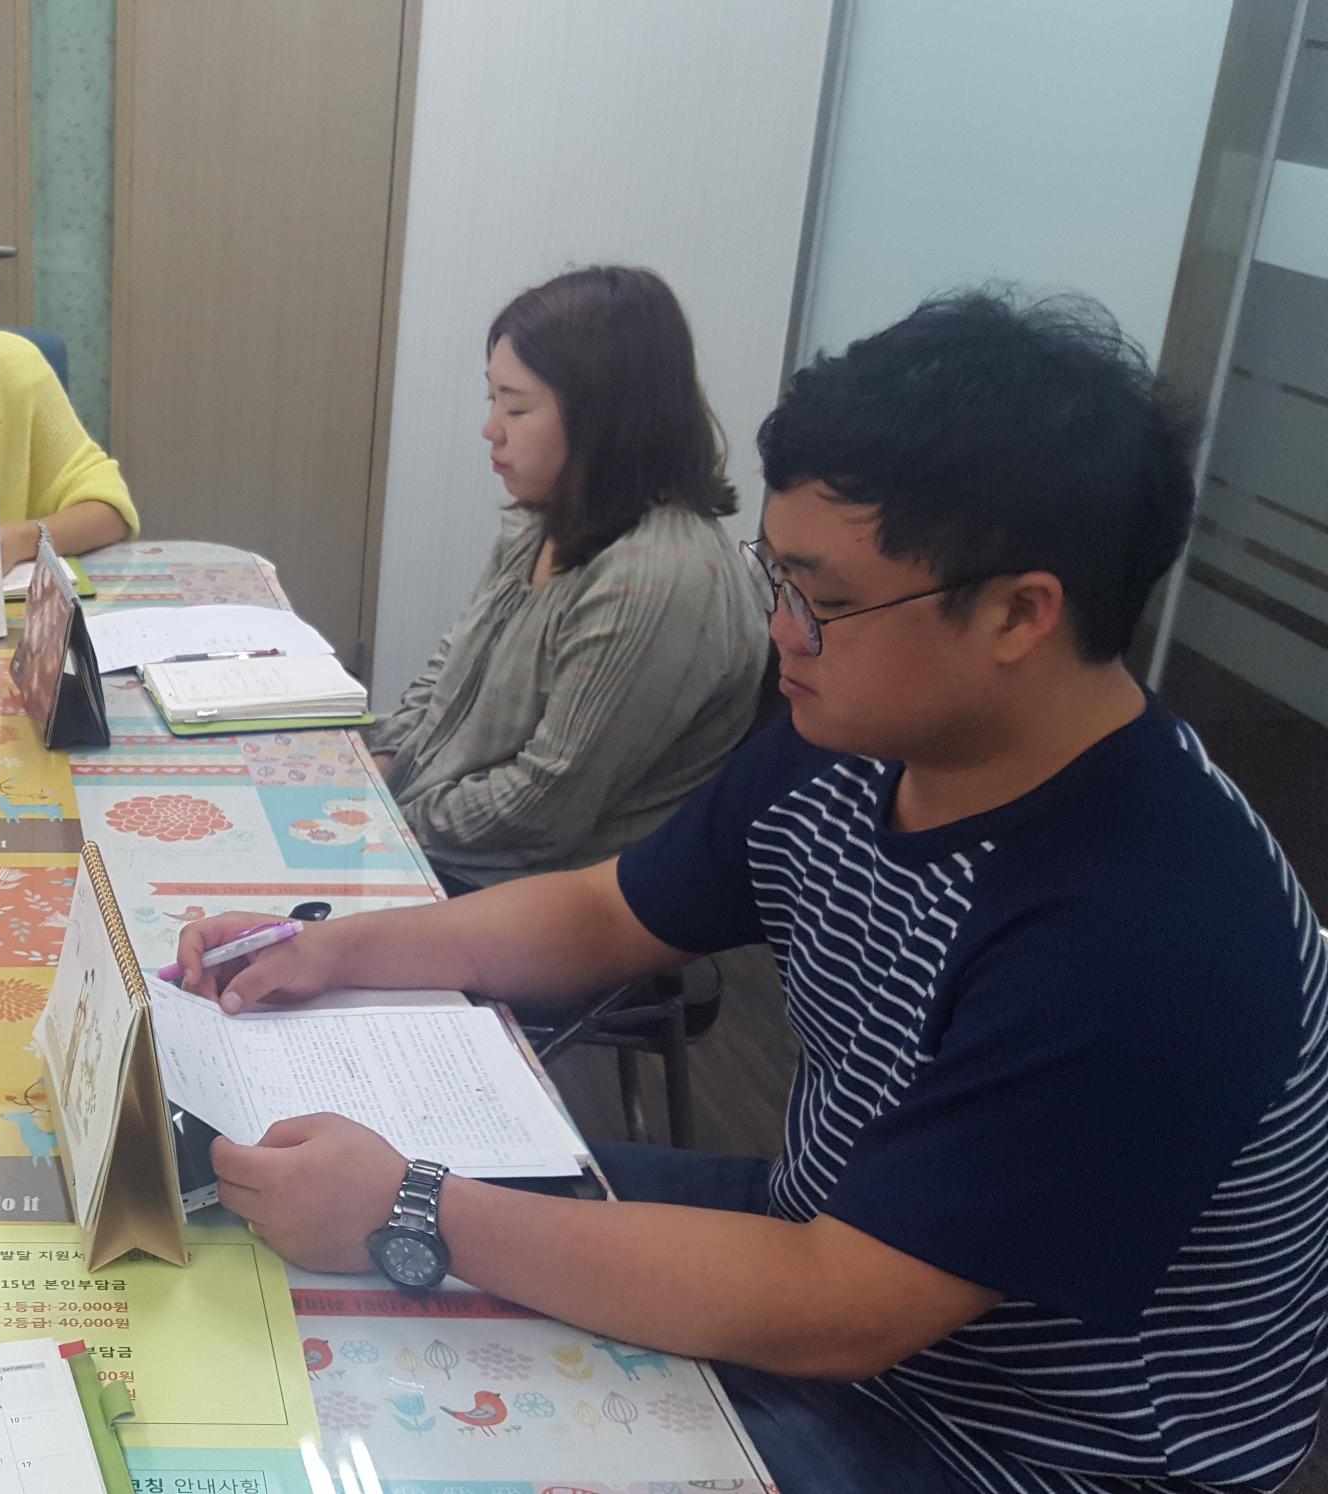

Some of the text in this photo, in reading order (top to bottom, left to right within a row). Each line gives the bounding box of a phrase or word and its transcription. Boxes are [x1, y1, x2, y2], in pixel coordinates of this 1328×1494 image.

[23, 1197, 40, 1212] it
[38, 1250, 84, 1262] 지원서
[43, 1279, 128, 1291] 본인부담금
[3, 1301, 129, 1313] 1등급: 20,000원
[2, 1317, 129, 1329] 2등급: 40,000원
[174, 1478, 261, 1494] 안내사항
